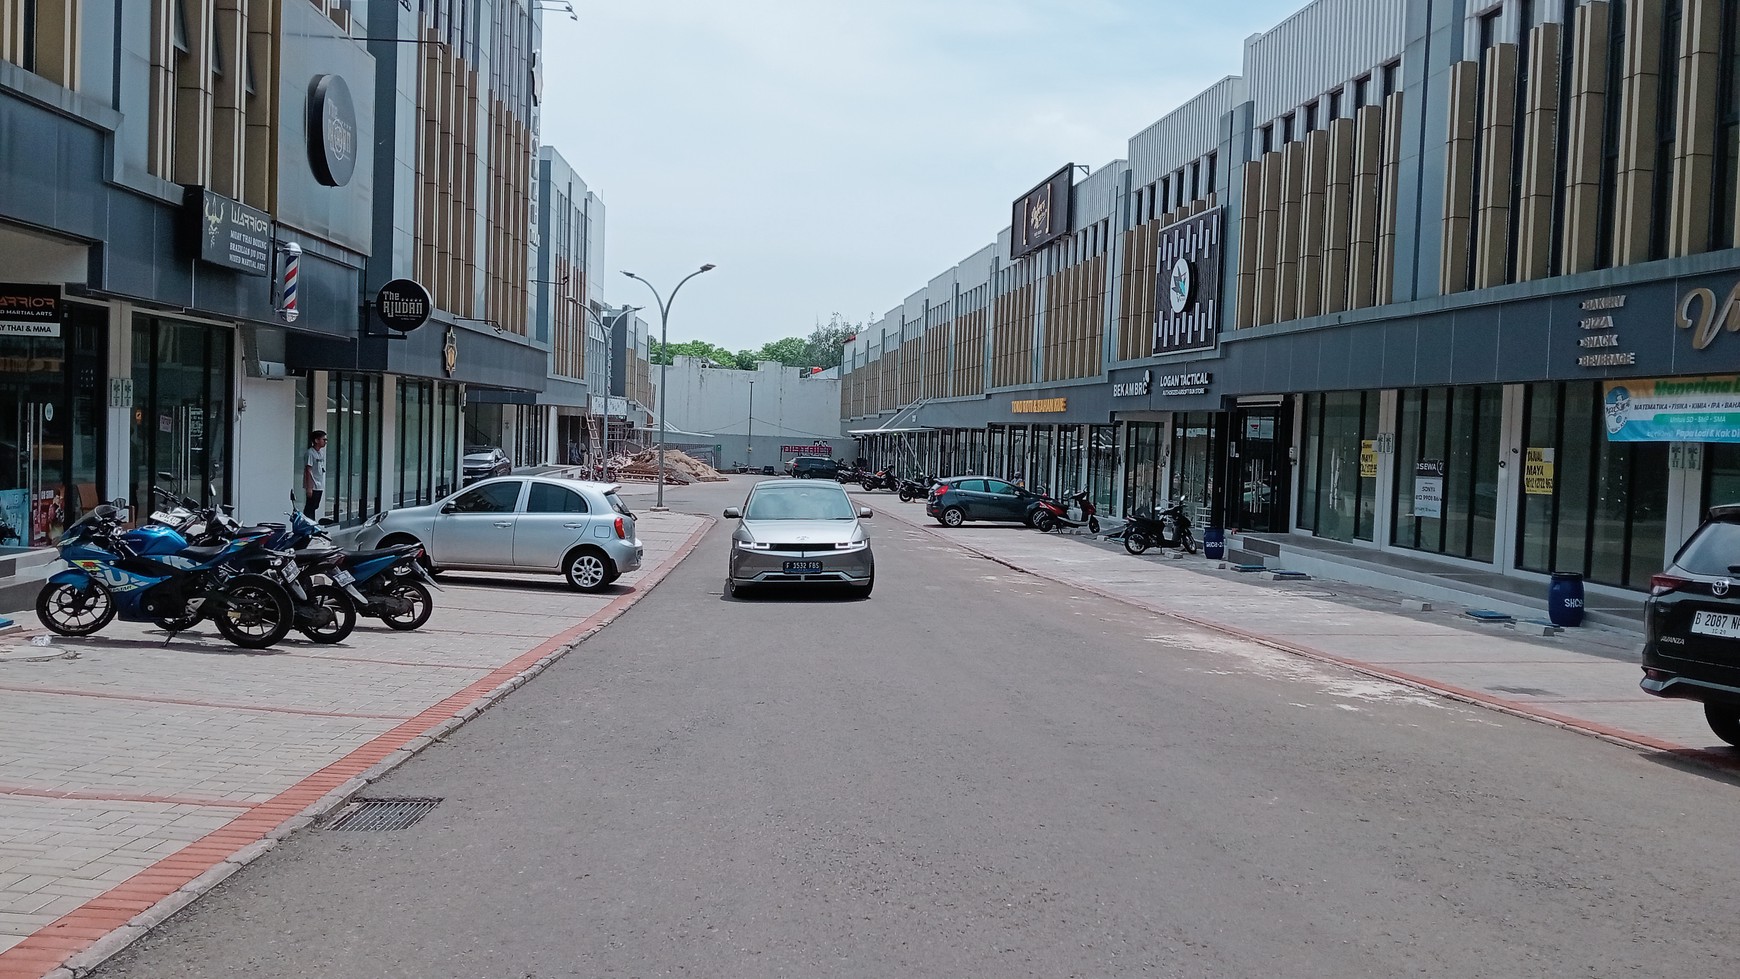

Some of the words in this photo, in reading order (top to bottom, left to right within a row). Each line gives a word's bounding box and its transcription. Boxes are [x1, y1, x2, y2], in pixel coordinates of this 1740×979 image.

[231, 203, 268, 236] WARRIOR
[242, 234, 252, 245] THAI
[241, 257, 256, 269] MARTIAL
[257, 262, 266, 272] ARTS
[383, 291, 400, 301] The
[1581, 316, 1613, 329] PIZZA
[1580, 335, 1618, 347] SNACK
[1579, 353, 1635, 366] BEVERAGE
[1160, 374, 1179, 387] LOGAN
[1180, 372, 1209, 386] TACTICAL
[1675, 430, 1695, 439] Papa
[1715, 429, 1730, 438] Kak
[1526, 465, 1544, 476] MAYA
[1695, 612, 1702, 625] B
[1705, 614, 1728, 628] 2087
[1660, 635, 1685, 645] AVANZA
